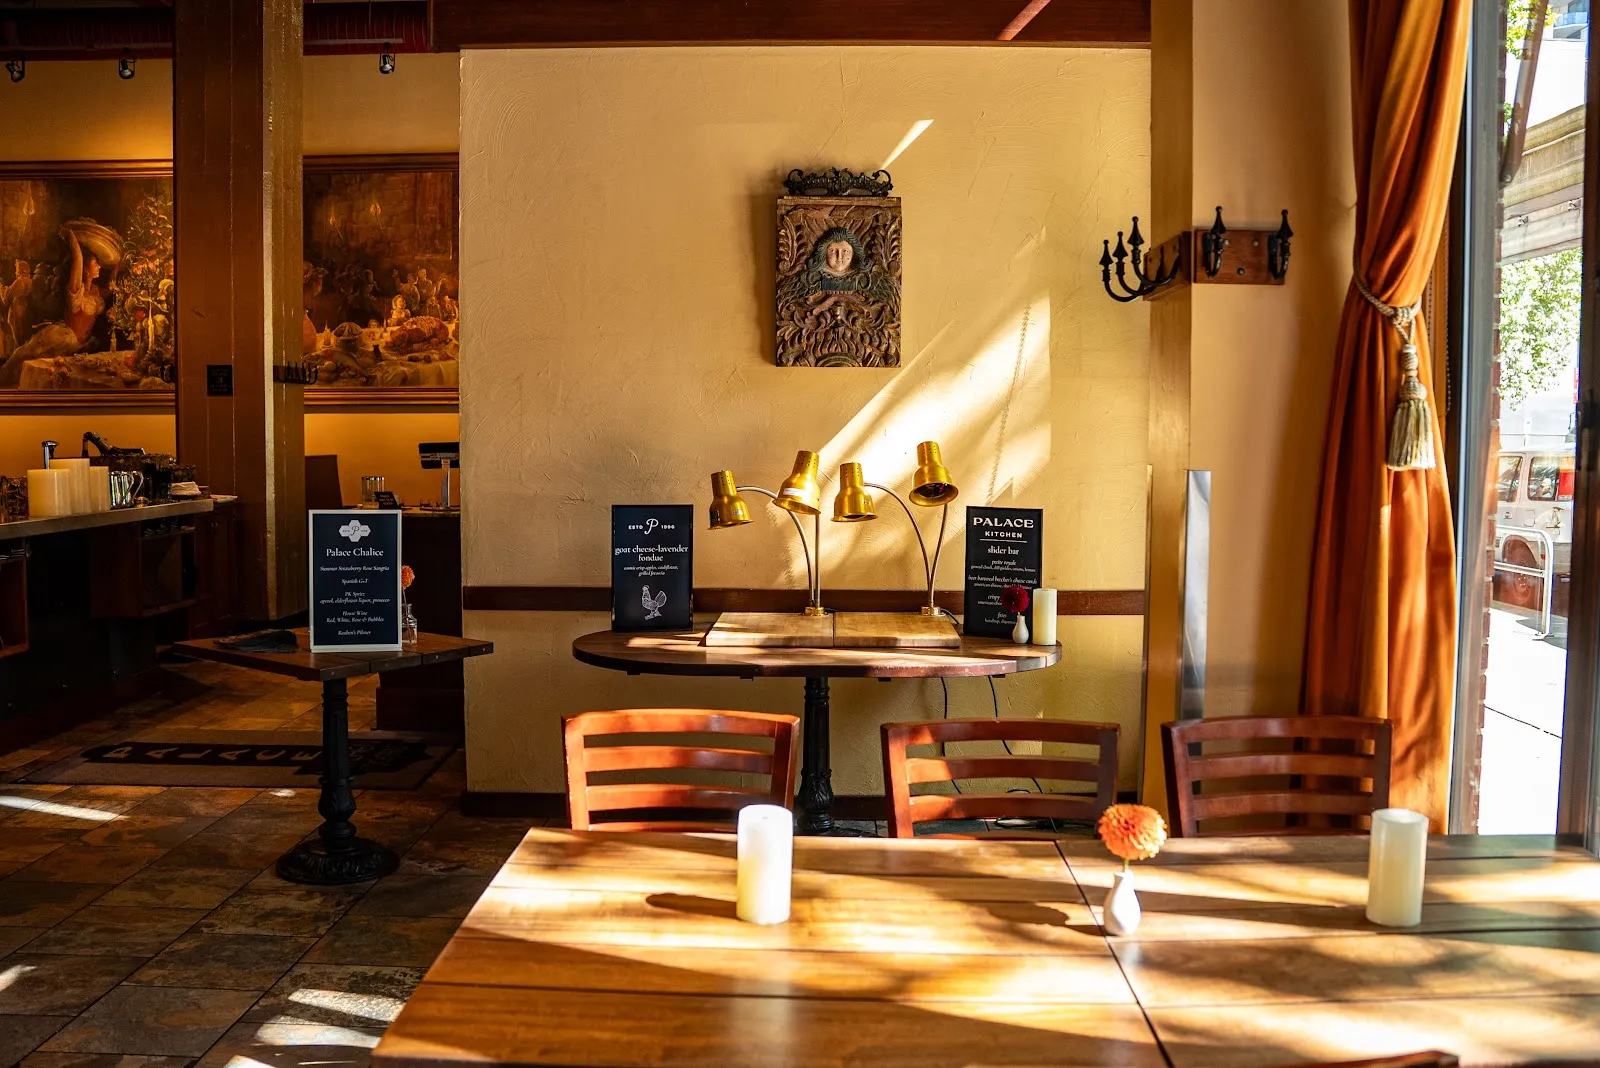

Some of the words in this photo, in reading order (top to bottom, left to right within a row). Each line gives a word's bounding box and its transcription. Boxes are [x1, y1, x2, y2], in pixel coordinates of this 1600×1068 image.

[644, 518, 659, 535] P
[973, 517, 1034, 528] PALACE
[326, 548, 351, 557] Palace
[353, 547, 384, 556] Chalice
[615, 546, 630, 555] goat
[632, 544, 689, 553] cheese-lavender
[988, 546, 1007, 554] slider
[1008, 546, 1019, 555] bar
